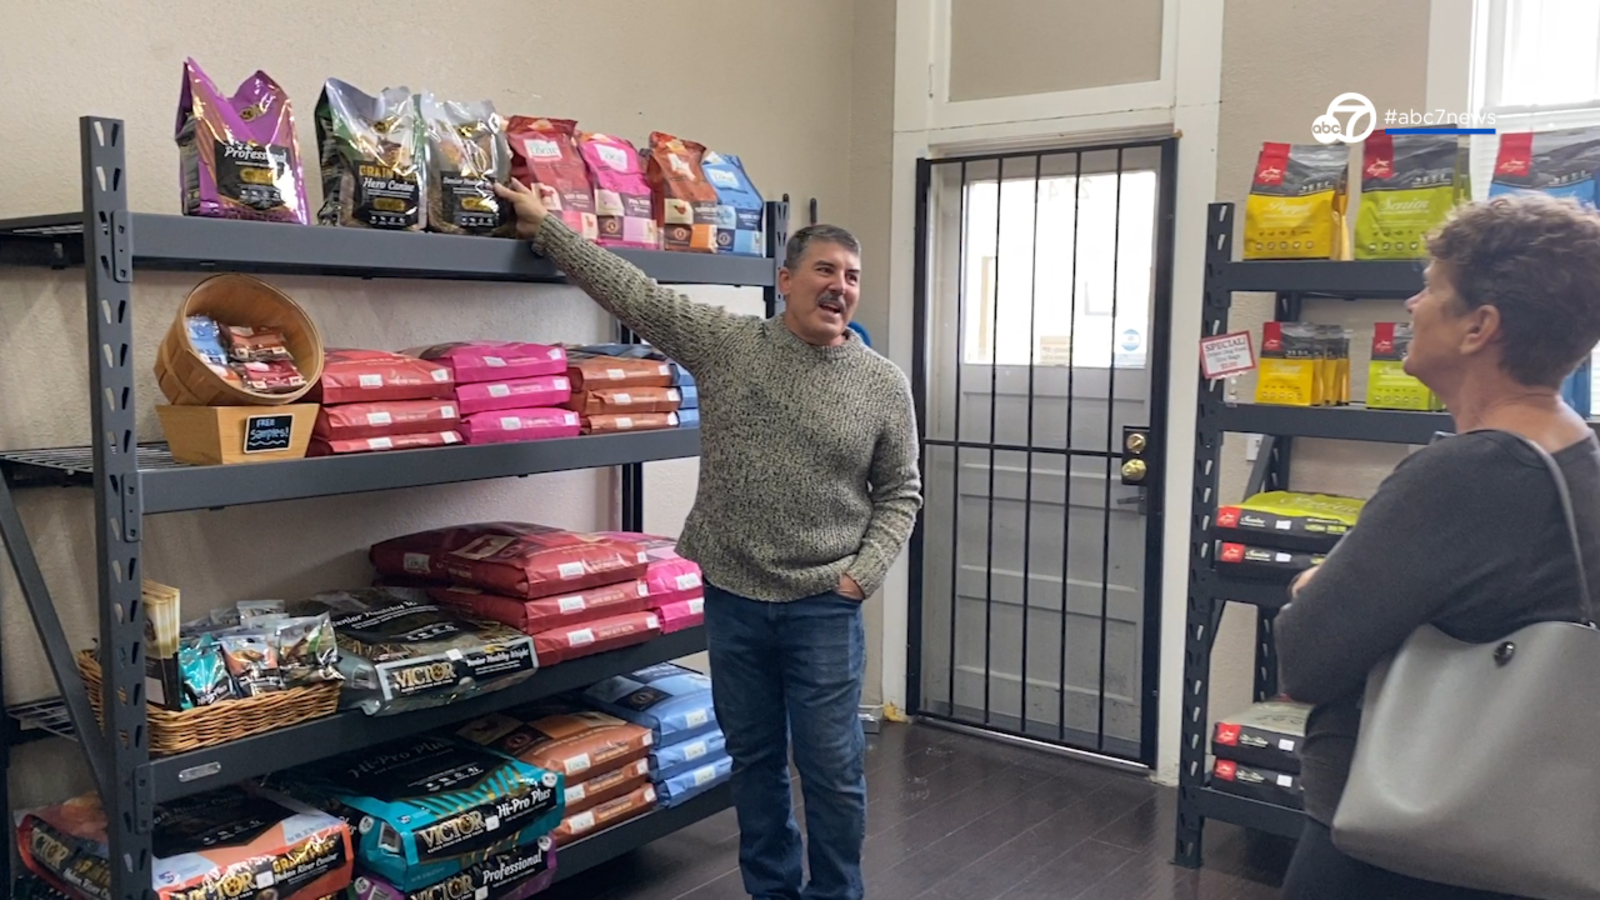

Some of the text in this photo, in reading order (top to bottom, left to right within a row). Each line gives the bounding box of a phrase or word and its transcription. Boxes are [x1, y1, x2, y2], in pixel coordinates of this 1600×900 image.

[362, 177, 386, 189] Hero
[393, 662, 457, 688] VICTOR
[497, 788, 552, 819] Hi-Pro Plus
[418, 810, 486, 848] VICTOR
[482, 848, 542, 885] Professional
[410, 875, 476, 900] ICTOR
